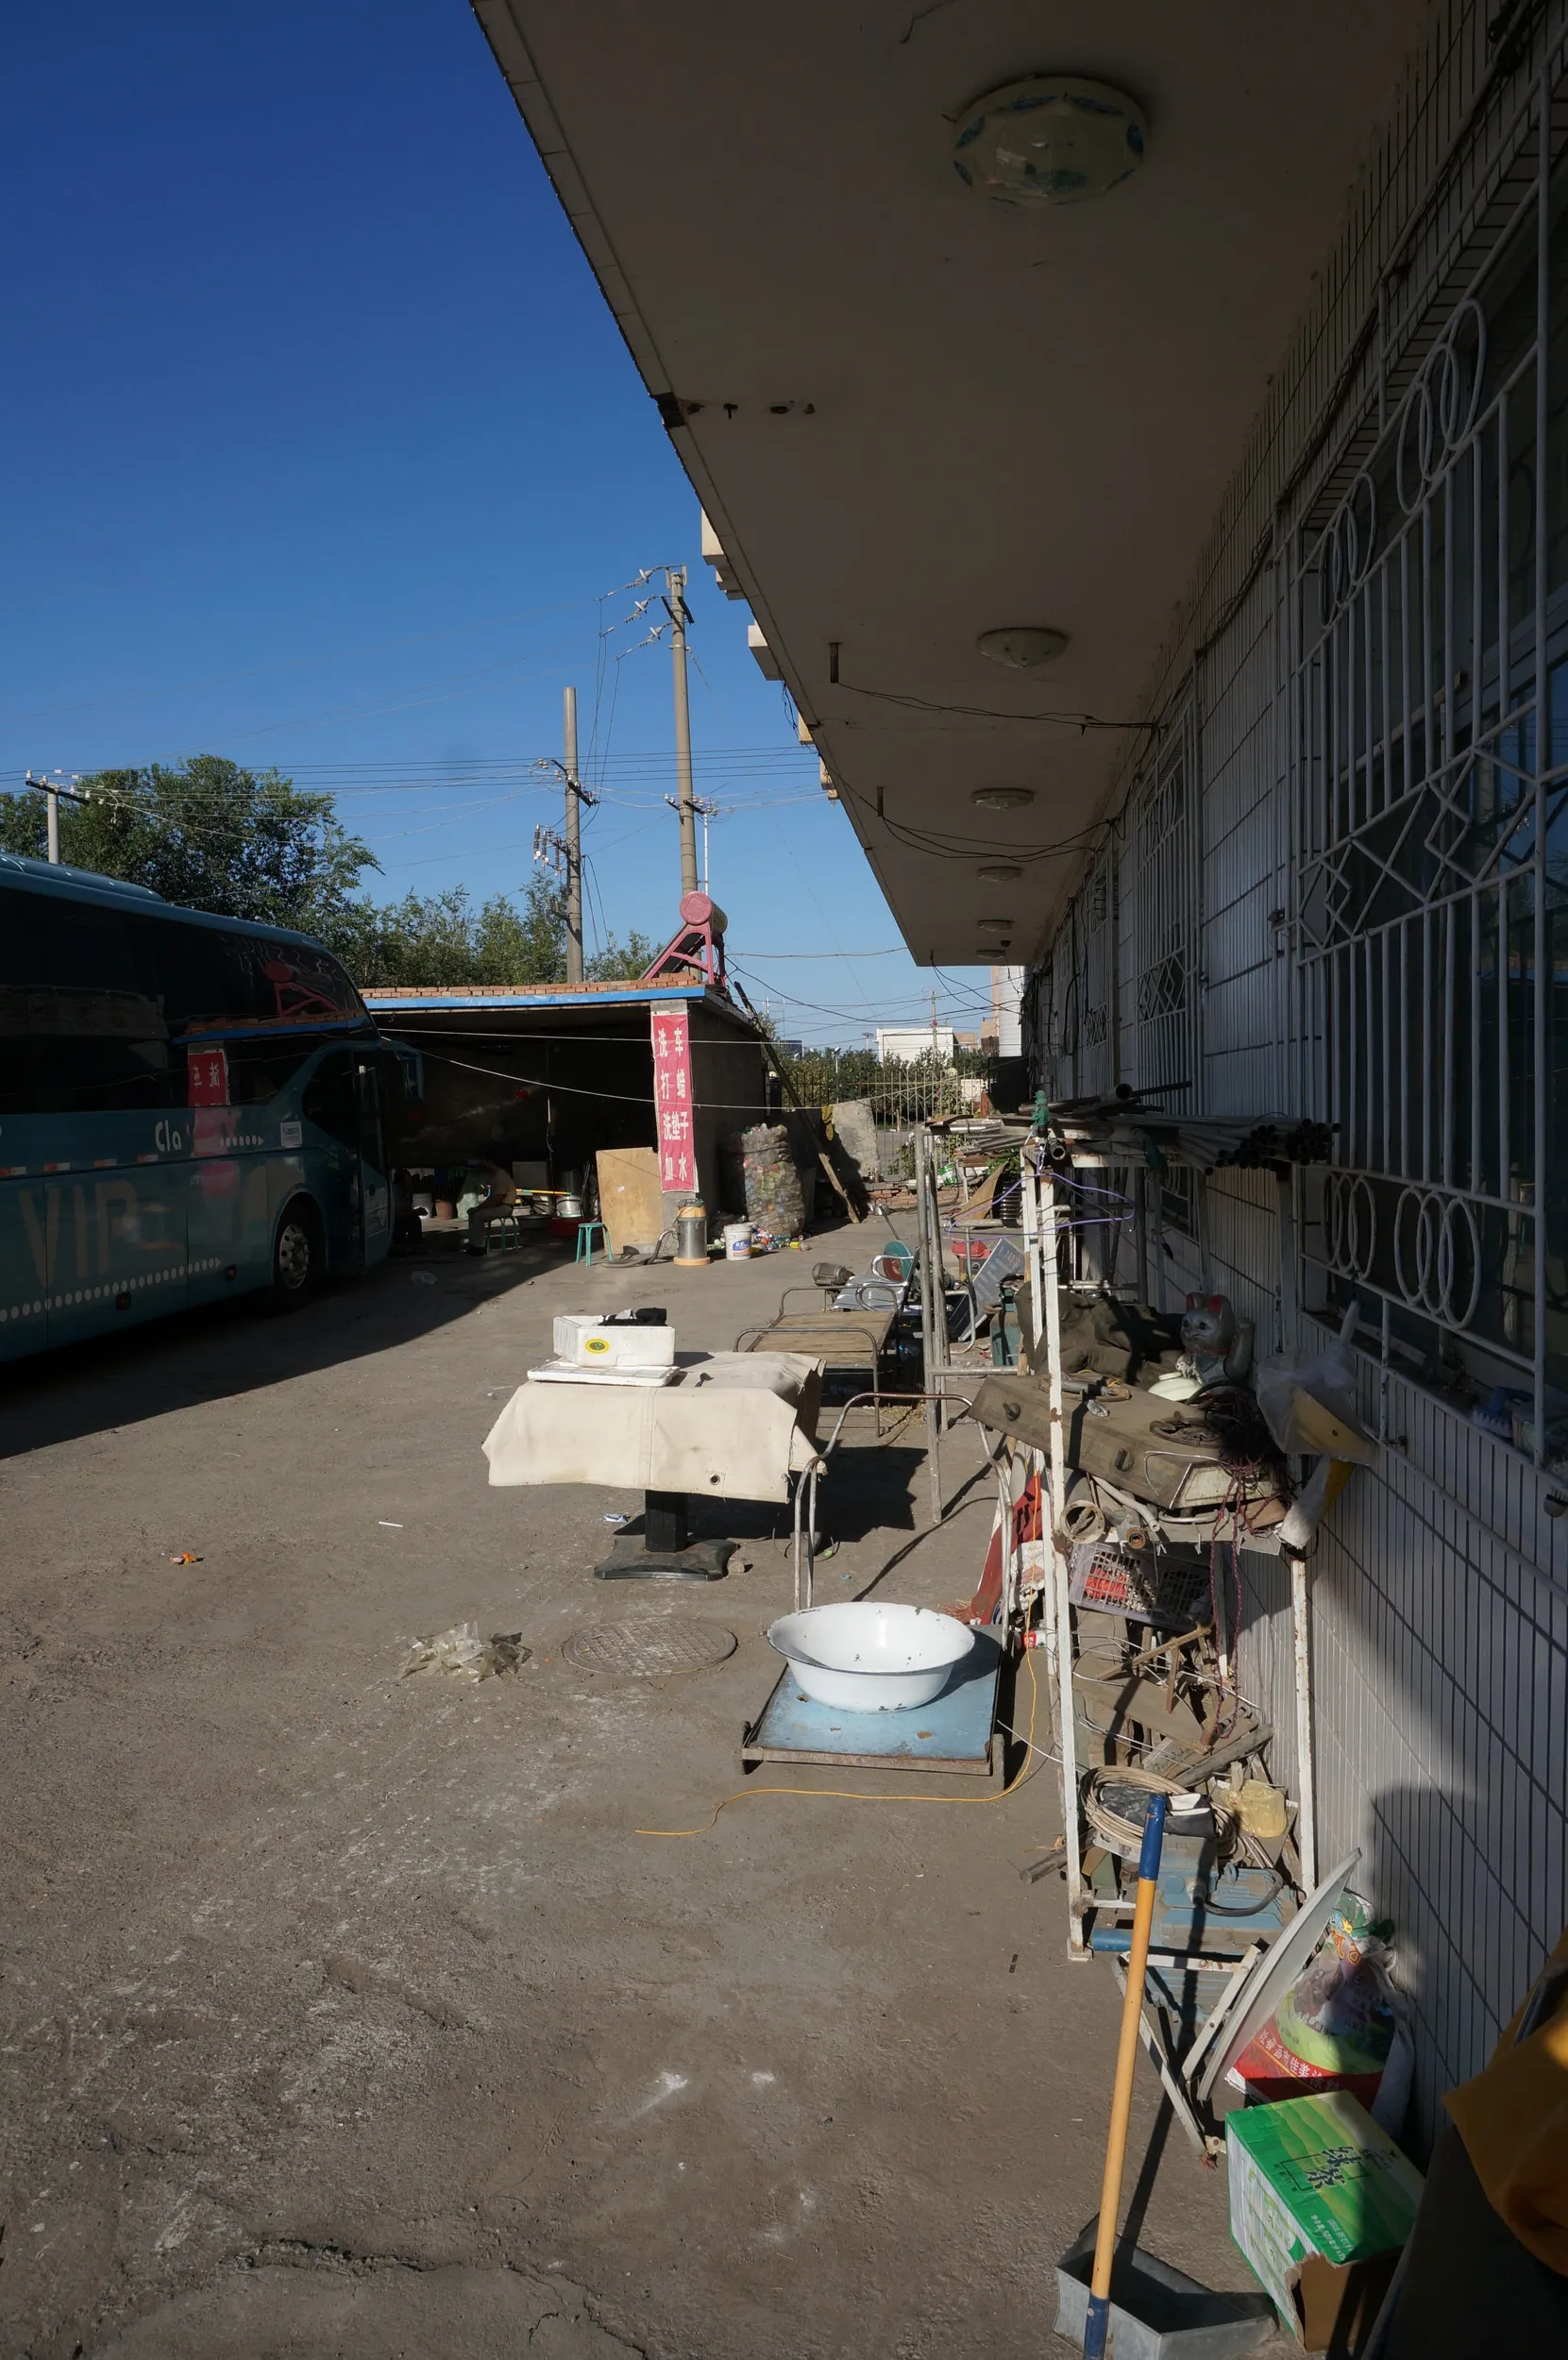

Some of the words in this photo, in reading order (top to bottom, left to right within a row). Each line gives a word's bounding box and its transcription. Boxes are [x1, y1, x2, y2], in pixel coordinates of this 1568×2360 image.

[658, 1027, 684, 1058] 洗车
[660, 1069, 686, 1100] 打蜡
[663, 1111, 689, 1140] 洗垫子
[665, 1152, 687, 1181] 加水
[18, 1179, 140, 1289] VIP
[1307, 2146, 1361, 2190] 绿茶
